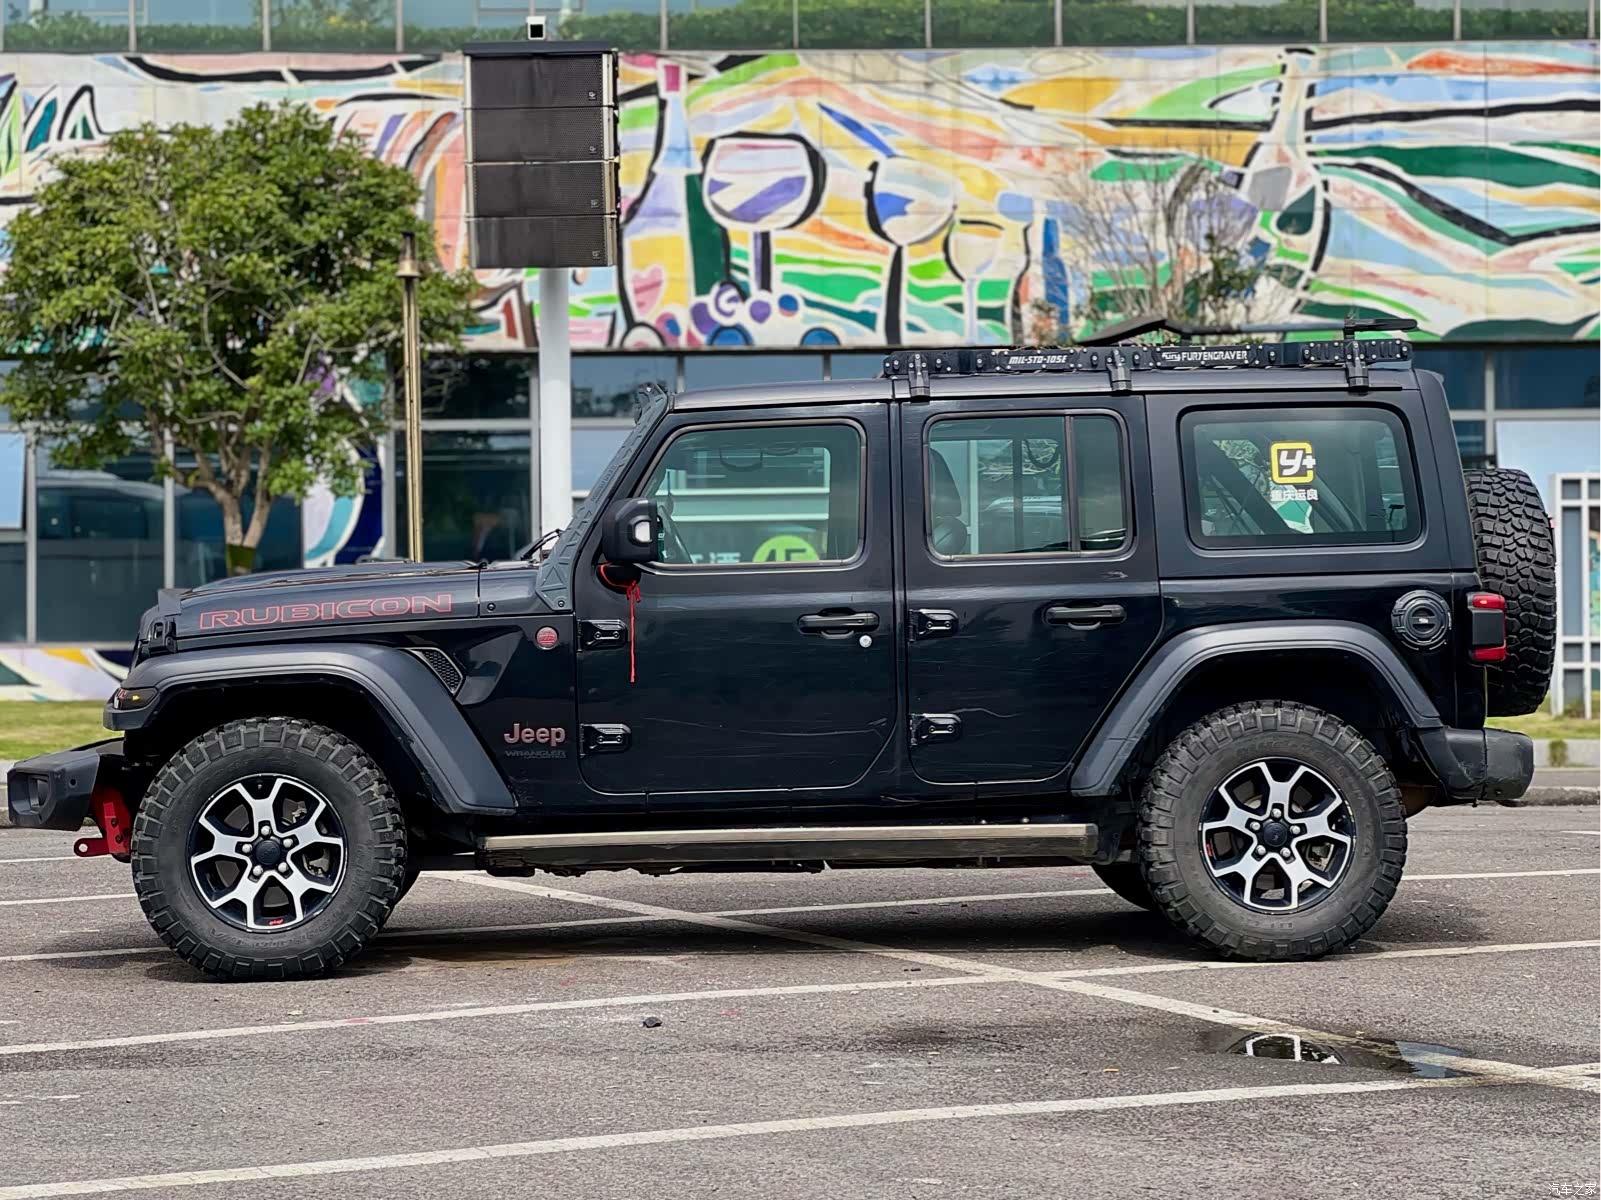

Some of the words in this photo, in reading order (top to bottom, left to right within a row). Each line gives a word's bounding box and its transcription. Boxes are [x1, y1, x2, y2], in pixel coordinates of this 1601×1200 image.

[1181, 350, 1248, 361] FURYENGRAVER
[199, 594, 452, 630] RUBICON
[503, 723, 566, 747] Jeep
